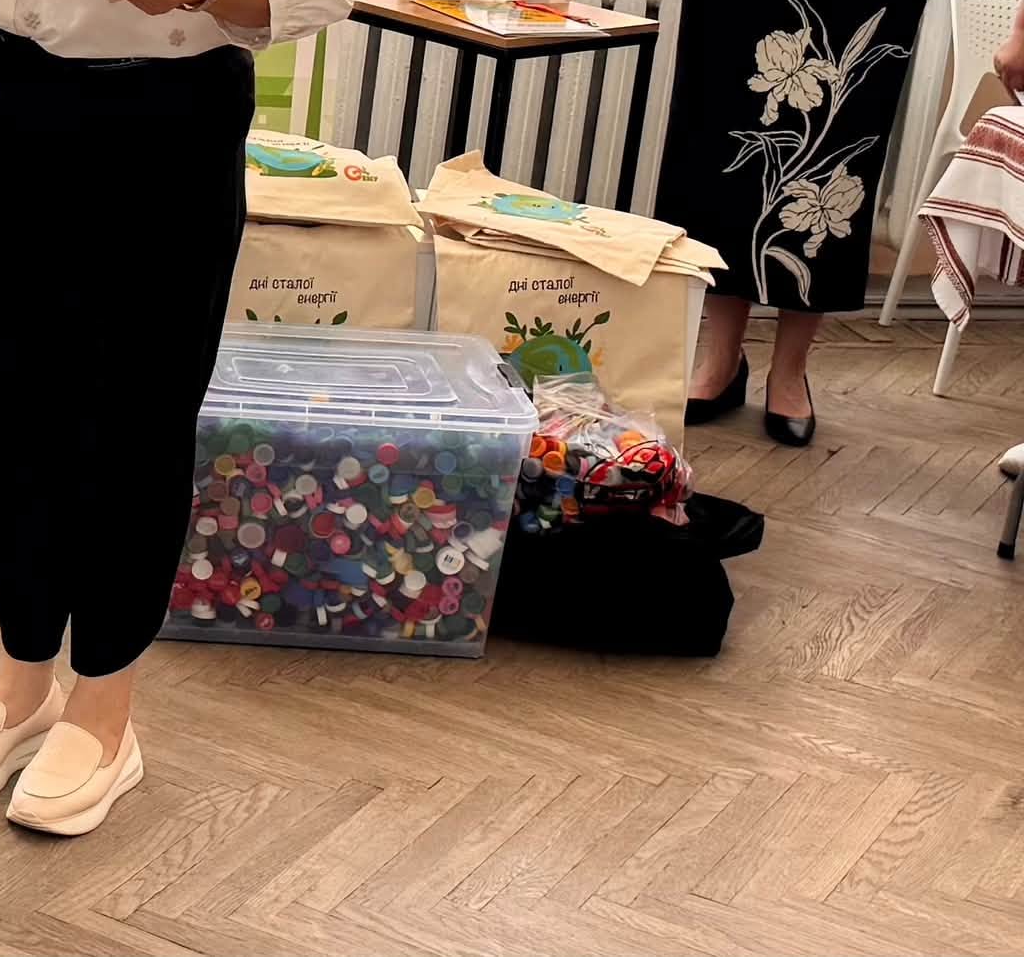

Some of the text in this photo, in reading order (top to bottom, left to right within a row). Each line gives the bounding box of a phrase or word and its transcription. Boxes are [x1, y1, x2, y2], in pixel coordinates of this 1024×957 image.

[248, 275, 315, 291] дні сталої
[508, 276, 575, 294] дні сталої
[297, 290, 338, 309] енергії
[558, 290, 601, 308] енергії
